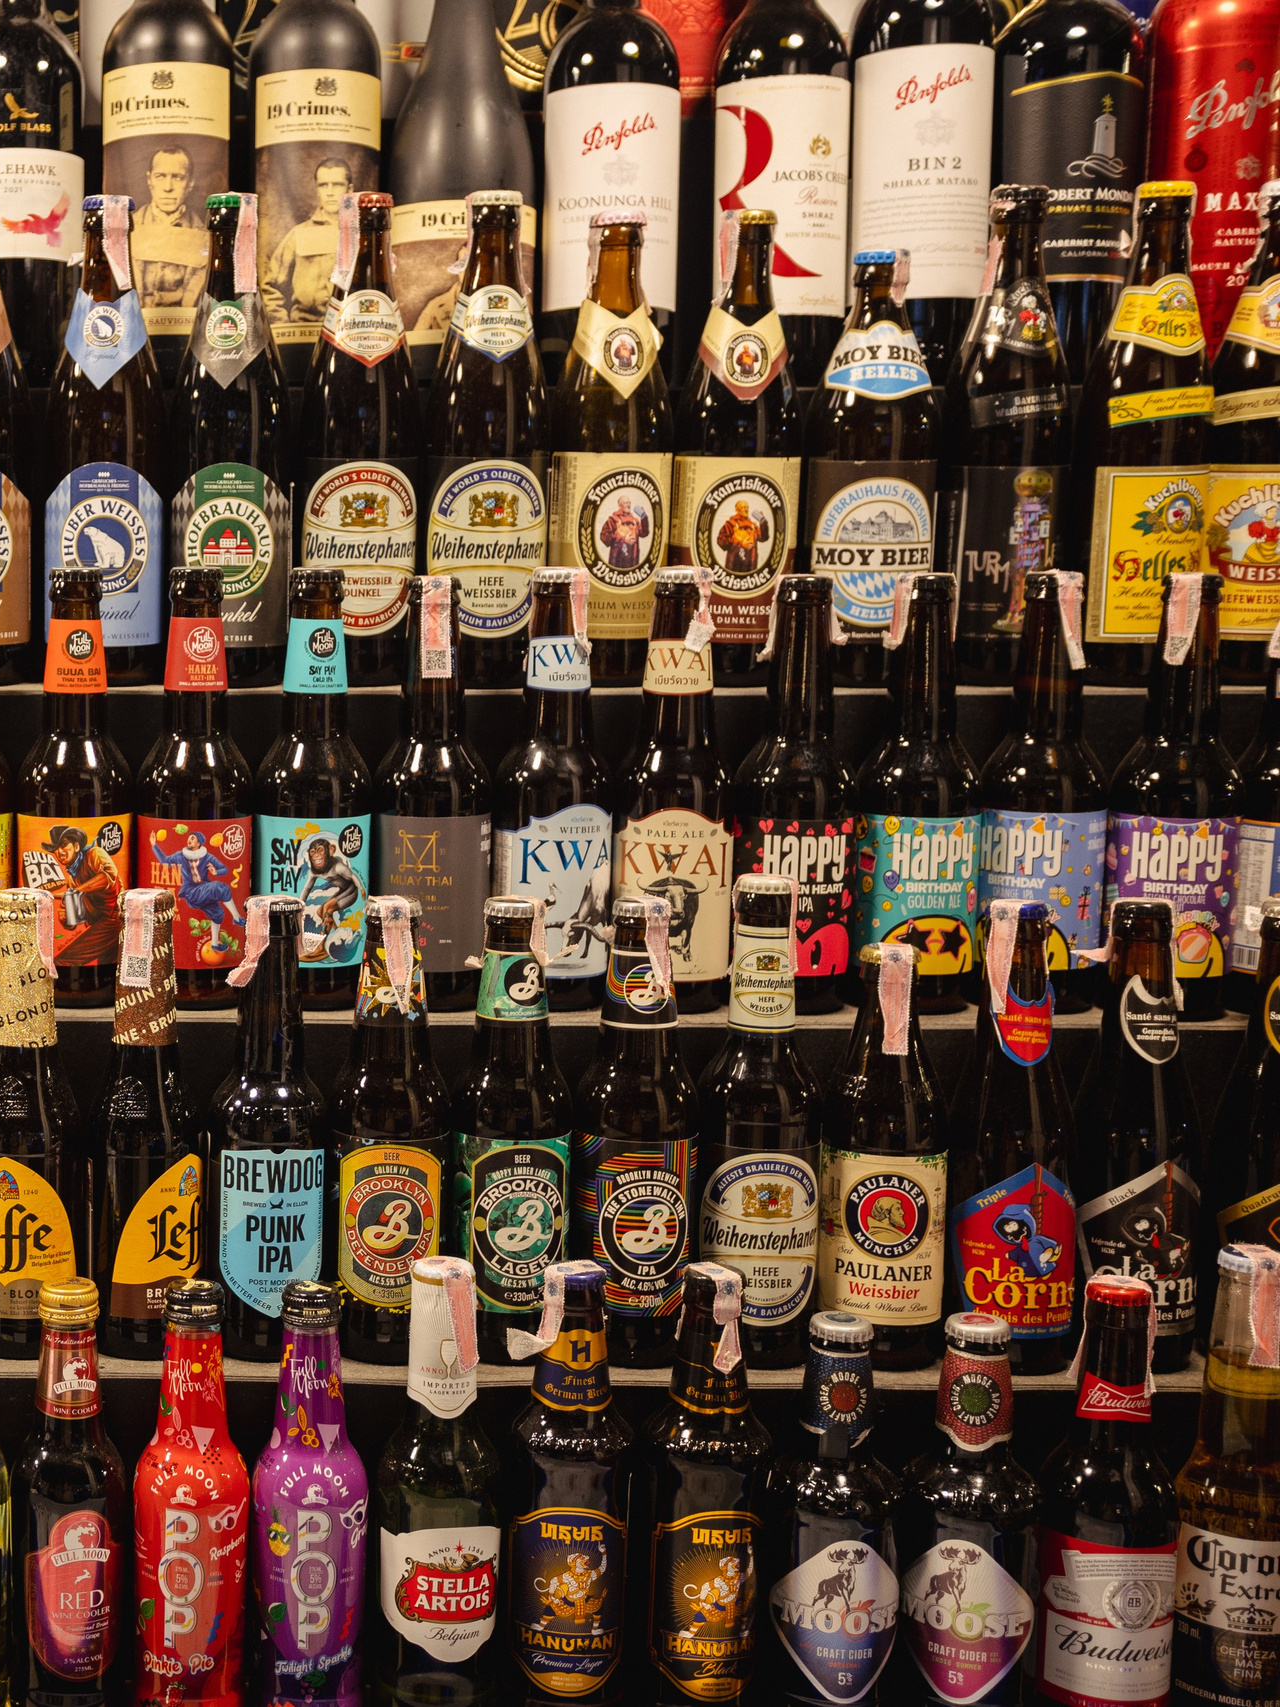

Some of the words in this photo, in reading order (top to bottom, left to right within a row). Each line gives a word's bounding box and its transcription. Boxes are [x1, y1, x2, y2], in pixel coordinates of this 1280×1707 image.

[895, 64, 971, 110] Penfolds
[21, 123, 52, 133] BLASS
[582, 112, 657, 156] Penfolds
[908, 157, 946, 171] BIN
[952, 157, 962, 169] 2
[883, 179, 927, 189] SHIRAZ
[931, 176, 978, 186] MATARO
[558, 196, 638, 211] KOONUNGA
[642, 194, 672, 211] HILL
[833, 348, 884, 369] MOY
[850, 365, 918, 382] HELLES
[588, 472, 661, 507] Franziskaner
[705, 475, 782, 509] Franziskaner
[62, 505, 97, 556] HUBER
[100, 499, 148, 559] WEISSES
[186, 499, 270, 558] HOFBRAUHAUS
[305, 531, 416, 560] Weihenstephaner
[431, 530, 544, 561] Weihenstephaner
[816, 548, 876, 566] MOY
[880, 547, 930, 566] BIER
[478, 576, 505, 587] HEFE
[594, 561, 652, 587] Weissbier
[463, 588, 517, 599] WEISSBIER
[717, 616, 757, 625] DUNKEL
[56, 667, 78, 676] SUUA
[81, 668, 102, 677] BAI
[188, 664, 218, 676] HANZA
[308, 665, 322, 676] SAY
[324, 666, 336, 676] PLAY
[560, 825, 601, 834] WITBIER
[647, 829, 677, 838] PALE
[683, 830, 705, 838] ALE
[270, 838, 302, 865] SAY
[271, 863, 301, 894] PLAY
[390, 875, 420, 885] MUAY
[423, 876, 453, 885] THAI
[905, 882, 963, 893] BIRTHDAY
[988, 874, 1046, 889] BIRTHDAY
[1143, 882, 1208, 894] BIRTHDAY
[812, 883, 844, 895] HEART
[908, 895, 946, 909] GOLDEN
[948, 894, 961, 908] ALE
[384, 1152, 400, 1162] BEER
[514, 1154, 531, 1164] BEER
[223, 1155, 323, 1194] BREWDOG
[353, 1179, 428, 1207] BROOKLYN
[479, 1179, 560, 1212] BROOKLYN
[849, 1175, 927, 1207] PAULANER
[1108, 1187, 1137, 1207] Black
[245, 1214, 305, 1243] PUNK
[703, 1215, 817, 1251] Weihenstephaner
[258, 1245, 293, 1274] IPA
[347, 1229, 415, 1274] DEFENDER
[637, 1265, 656, 1276] IPA
[753, 1266, 780, 1277] HEFE
[834, 1258, 932, 1282] PAULANER
[849, 1280, 920, 1300] Weissbier
[569, 1339, 591, 1363] H
[422, 1381, 471, 1390] IMPORTED
[416, 1574, 491, 1594] STELLA
[59, 1589, 104, 1610] RED
[415, 1592, 489, 1612] ARTOIS
[780, 1600, 897, 1634] MOOSE
[424, 1627, 480, 1646] Belgium
[521, 1627, 613, 1653] HANUMAN
[817, 1647, 846, 1659] CRAFT
[849, 1647, 873, 1659] CIDER
[927, 1641, 956, 1659] CRAFT
[959, 1649, 988, 1662] CIDER
[1220, 1646, 1276, 1660] CERVEZA
[1234, 1669, 1262, 1679] FINA
